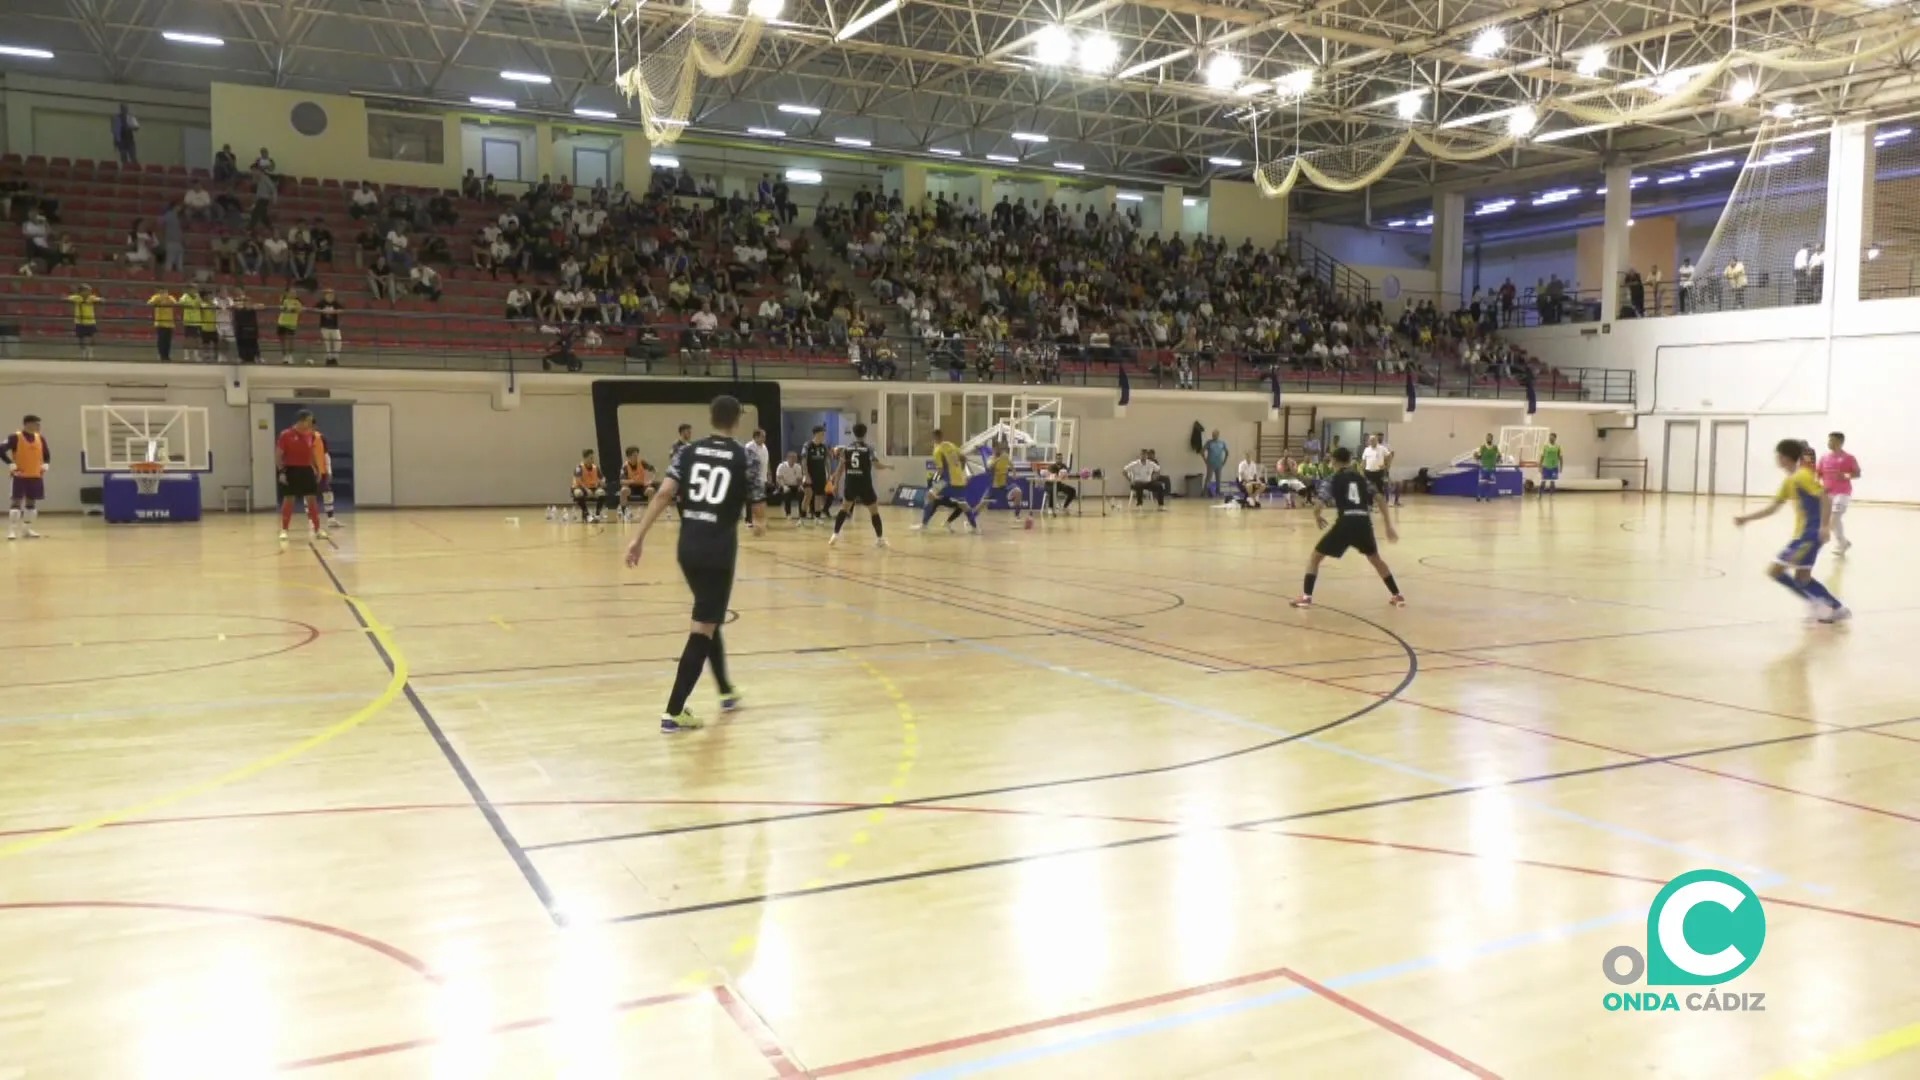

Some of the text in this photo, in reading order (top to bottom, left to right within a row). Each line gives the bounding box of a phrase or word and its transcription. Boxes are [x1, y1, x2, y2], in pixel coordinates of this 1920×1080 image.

[851, 451, 860, 469] 5
[688, 462, 731, 505] 50
[1347, 482, 1361, 505] 4
